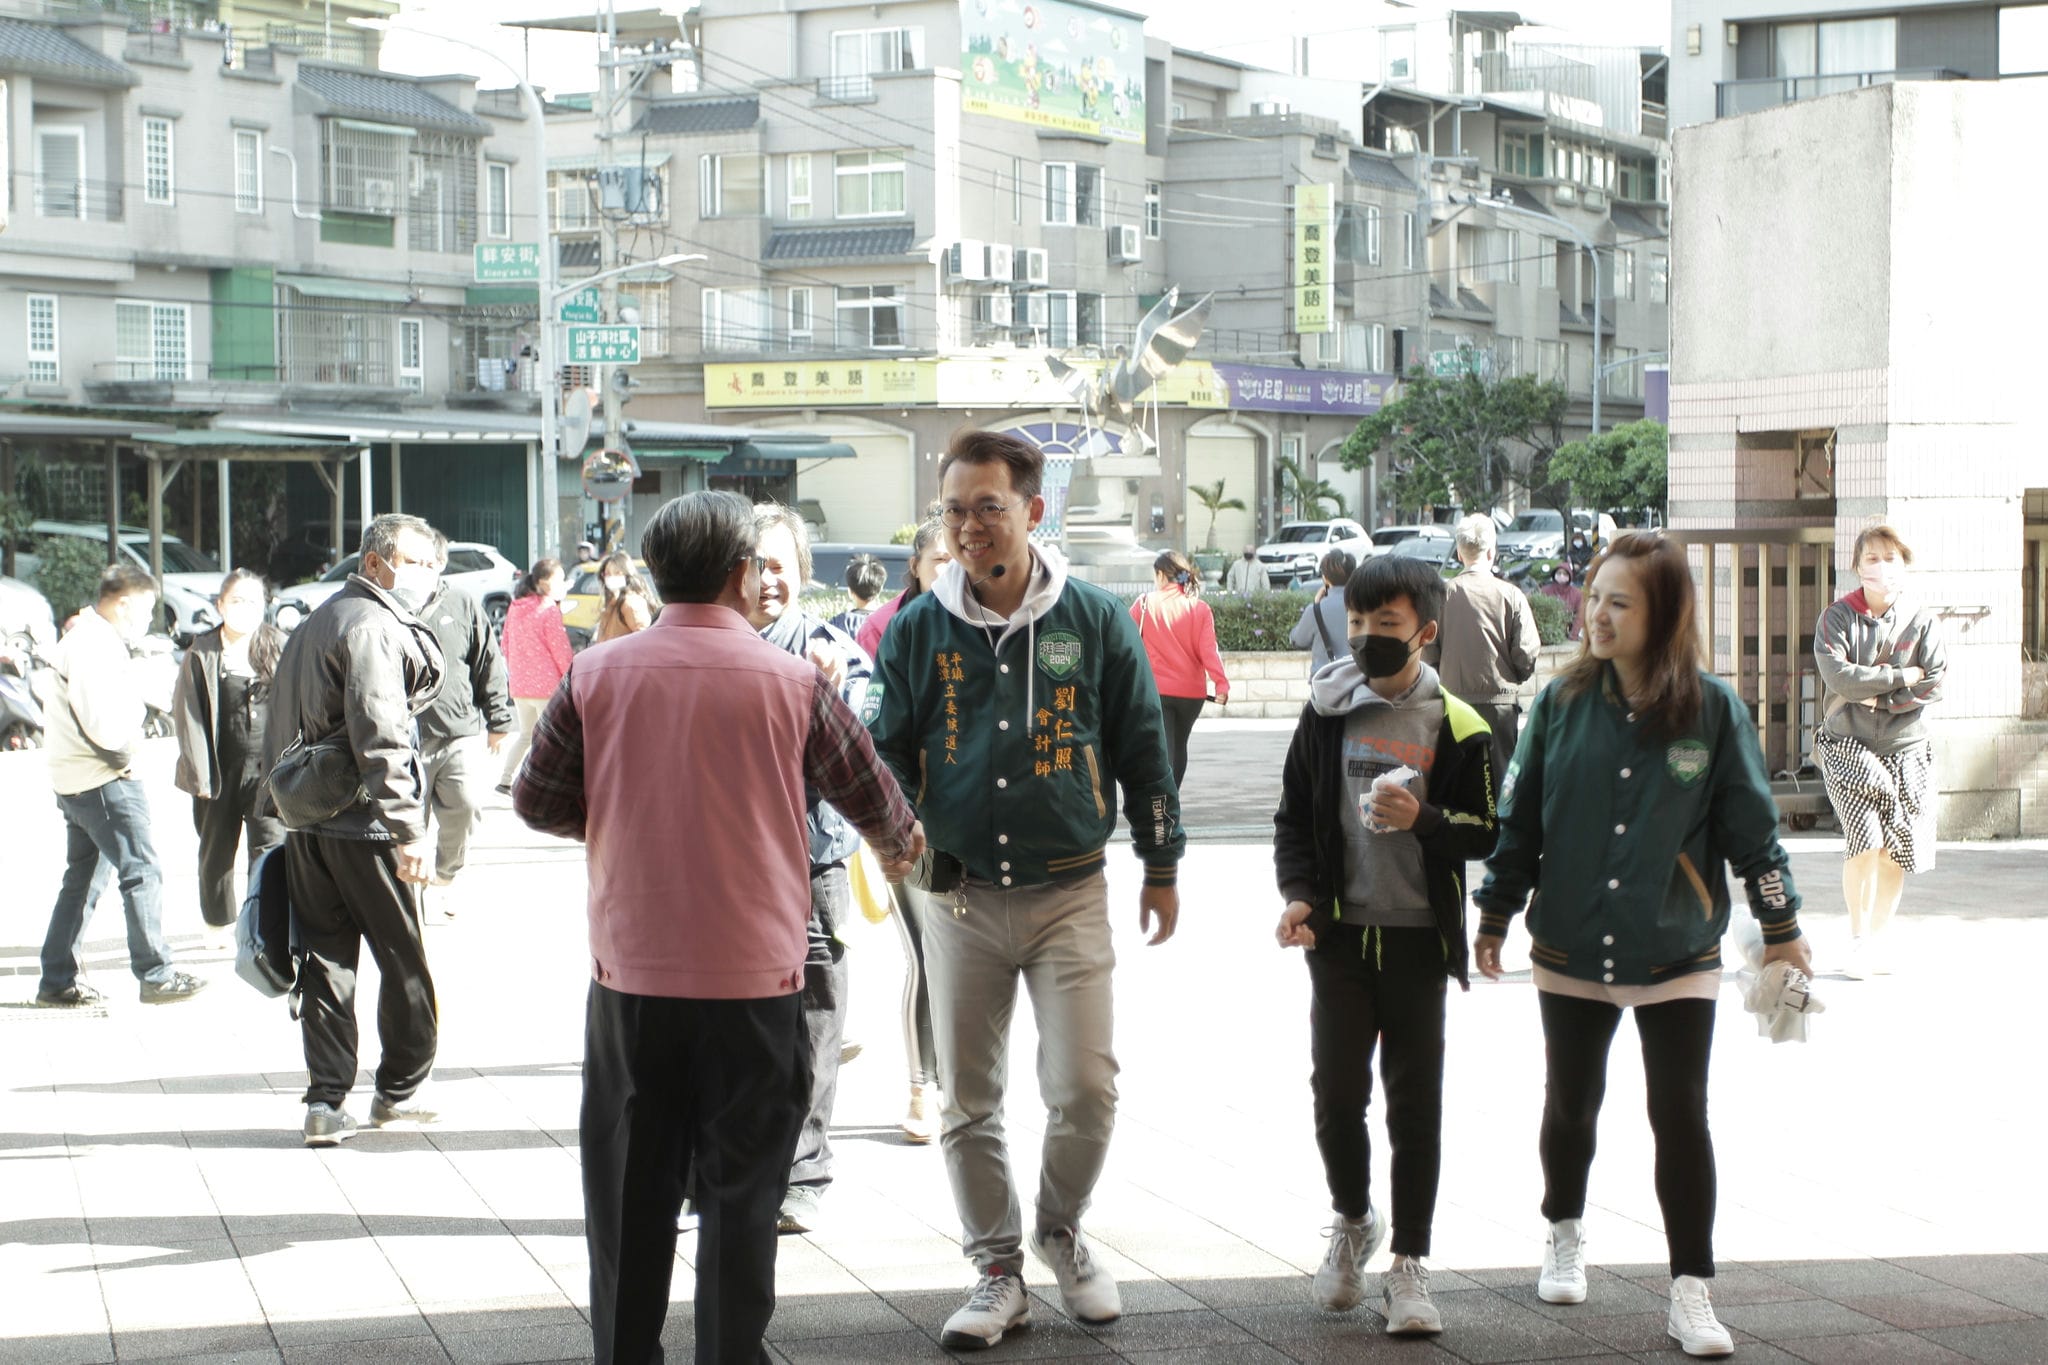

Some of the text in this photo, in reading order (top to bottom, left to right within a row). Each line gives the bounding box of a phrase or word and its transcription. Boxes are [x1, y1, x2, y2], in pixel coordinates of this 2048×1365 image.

[1303, 224, 1321, 307] 喬登美語
[575, 329, 631, 344] 山子頂社區
[575, 344, 631, 360] 活動中心
[752, 370, 863, 387] 喬登美語
[1049, 654, 1071, 665] 2024
[943, 683, 959, 765] 立委候選人
[1053, 686, 1075, 771] 劉仁照
[1034, 707, 1054, 778] 會計師
[1152, 799, 1164, 820] TEAM
[1758, 869, 1786, 909] 202
